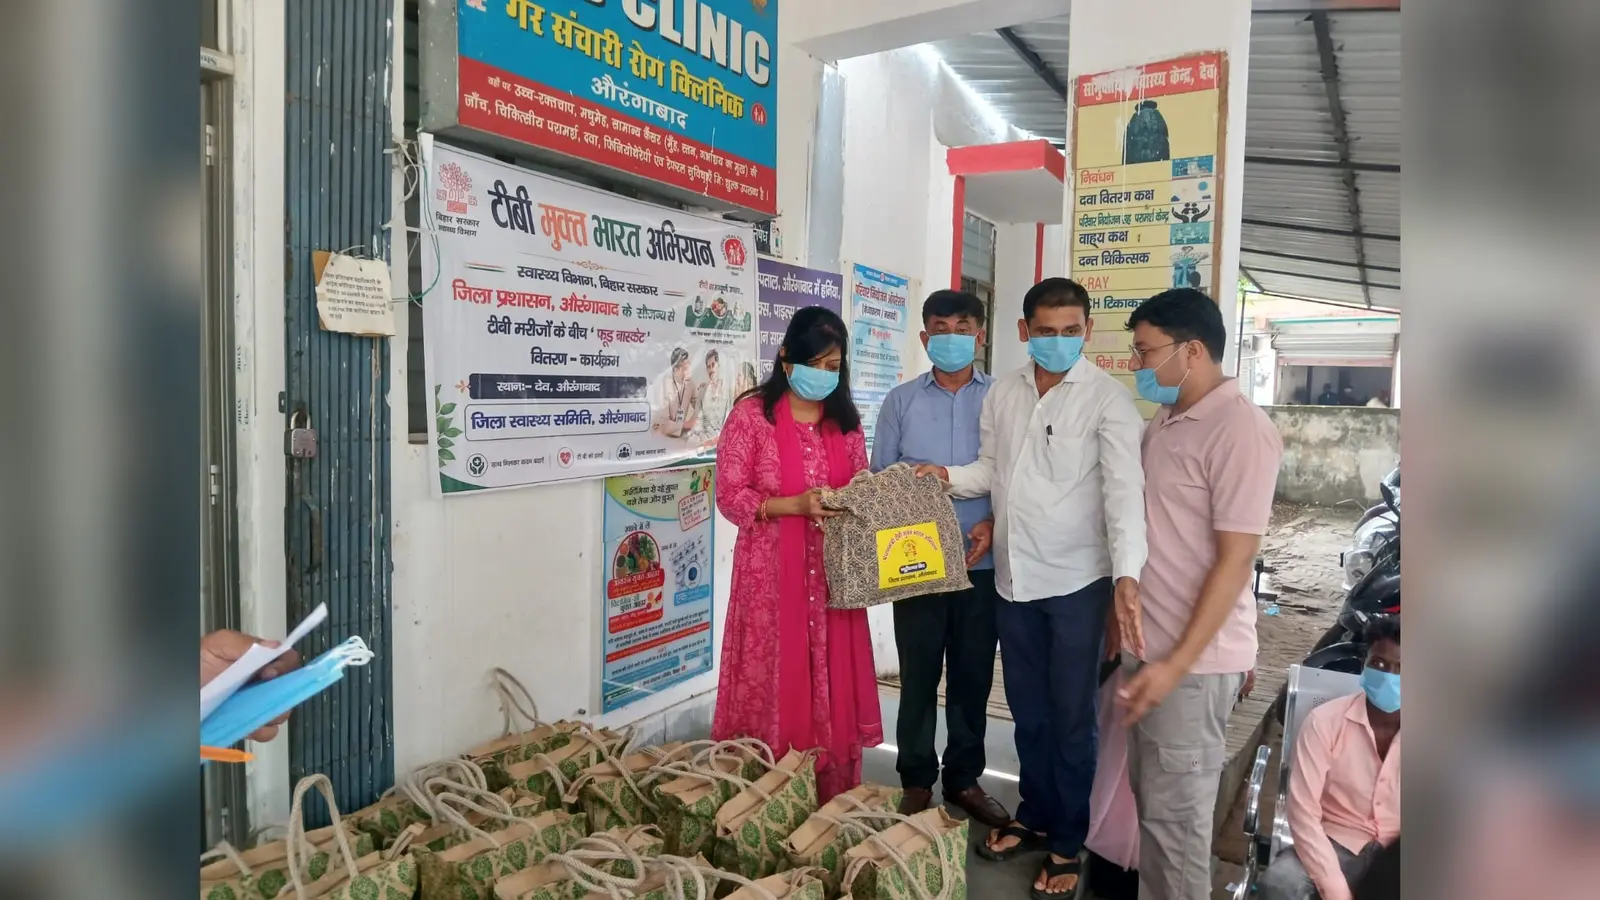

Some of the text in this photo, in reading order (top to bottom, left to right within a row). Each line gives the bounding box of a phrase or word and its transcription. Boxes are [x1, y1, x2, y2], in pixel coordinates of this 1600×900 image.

[551, 10, 622, 69] संचारी
[629, 40, 665, 87] रोग
[670, 60, 744, 118] क्लिनिक
[502, 81, 511, 91] पर
[514, 84, 577, 117] उच्च-रक्तचाप,
[580, 106, 609, 128] मधुमेह,
[611, 118, 642, 137] सामान्य
[591, 73, 688, 129] औरंगाबाद
[464, 92, 491, 115] जाँच,
[495, 100, 544, 128] चिकित्सीय
[547, 120, 581, 143] परामर्श,
[584, 132, 600, 149] दवा,
[1079, 188, 1155, 206] दवा वितरण कक्ष
[435, 211, 480, 228] बिहार सरकार
[487, 179, 536, 235] टीबी
[538, 202, 588, 251] मुक्त
[592, 214, 641, 258] भारत
[646, 219, 716, 267] अभियान
[1079, 213, 1097, 228] परिवार
[1097, 212, 1121, 227] नियोजन
[456, 227, 477, 237] विभाग
[1108, 230, 1129, 242] कक्ष
[1078, 250, 1151, 267] दन्त चिकित्सक
[517, 266, 659, 296] स्वास्थ्य विभाग, बिहार सरकार
[782, 271, 813, 295] औरंगाबाद
[452, 278, 676, 322] जिला प्रशासन, औरंगाबाद के सौजन्य से
[487, 314, 512, 335] टीबी
[514, 318, 553, 338] मरीजों
[553, 321, 566, 339] के
[568, 321, 588, 339] बीच
[531, 346, 568, 366] वितरण
[579, 350, 620, 369] कार्यक्रम
[534, 379, 553, 393] देव,
[556, 379, 601, 392] औरंगाबाद
[470, 408, 648, 430] जिला स्वास्थ्य समिति, औरंगाबाद
